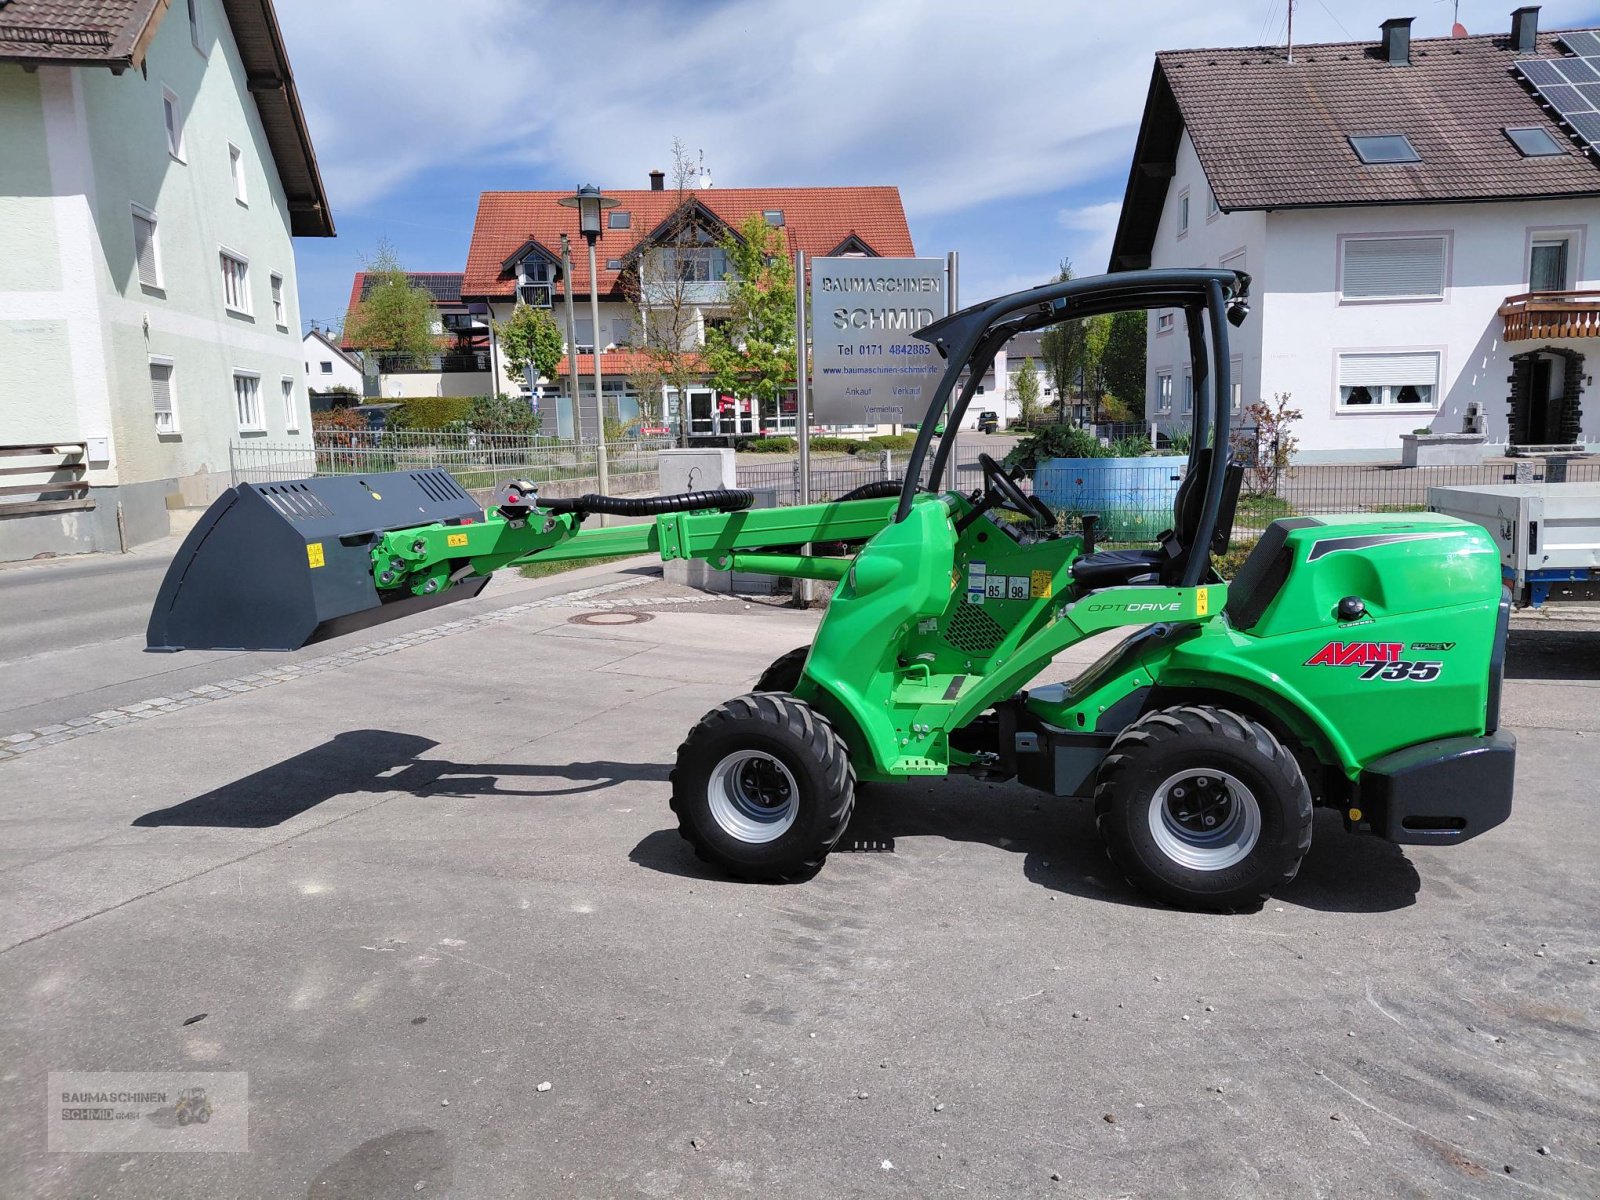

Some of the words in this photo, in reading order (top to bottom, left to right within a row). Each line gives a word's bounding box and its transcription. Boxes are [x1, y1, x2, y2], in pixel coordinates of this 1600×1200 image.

[822, 277, 940, 293] BAUMASCHINEN
[833, 308, 934, 330] SCHMID
[838, 344, 853, 356] Tel
[859, 344, 883, 355] 0171
[888, 344, 931, 355] 4842885
[823, 365, 938, 375] www.baumaschinen-schmid.de
[845, 387, 872, 396] Ankauf
[892, 386, 921, 396] Verkauf
[864, 405, 904, 415] Vermietung
[988, 585, 1000, 597] 85
[1011, 586, 1024, 599] 98
[1088, 602, 1182, 612] OPTIDRIVE
[1303, 640, 1405, 667] AVANT
[1358, 660, 1444, 683] 735
